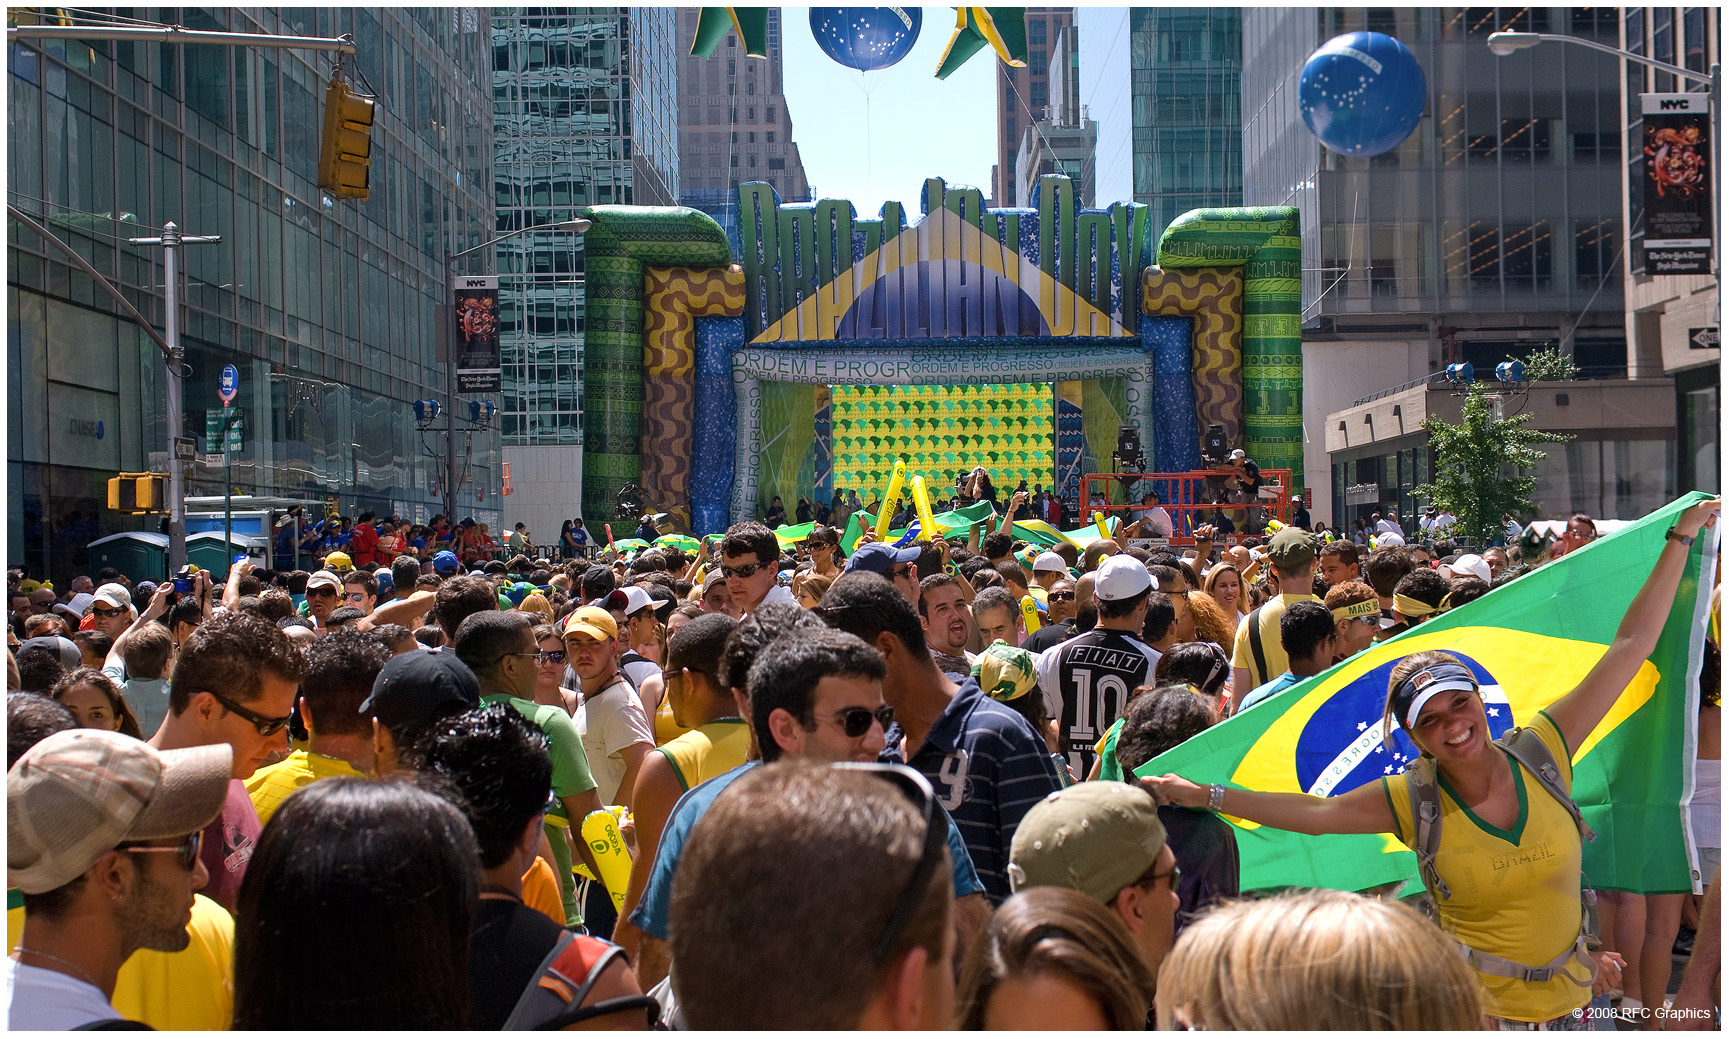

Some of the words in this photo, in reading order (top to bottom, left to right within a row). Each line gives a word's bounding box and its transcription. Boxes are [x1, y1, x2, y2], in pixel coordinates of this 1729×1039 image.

[1661, 100, 1689, 110] NYC
[738, 177, 1020, 342] BRAZILIAN
[1700, 333, 1718, 343] ONE
[732, 350, 807, 376] ORDEM
[814, 360, 827, 376] E
[911, 362, 958, 374] ORDEM
[961, 362, 970, 373] E
[973, 360, 1053, 373] PROGRESSO
[1348, 602, 1372, 615] MAIS
[1073, 648, 1137, 668] FIAT
[1069, 668, 1128, 740] 10
[938, 748, 968, 811] 9
[1491, 841, 1555, 871] BRAZIL
